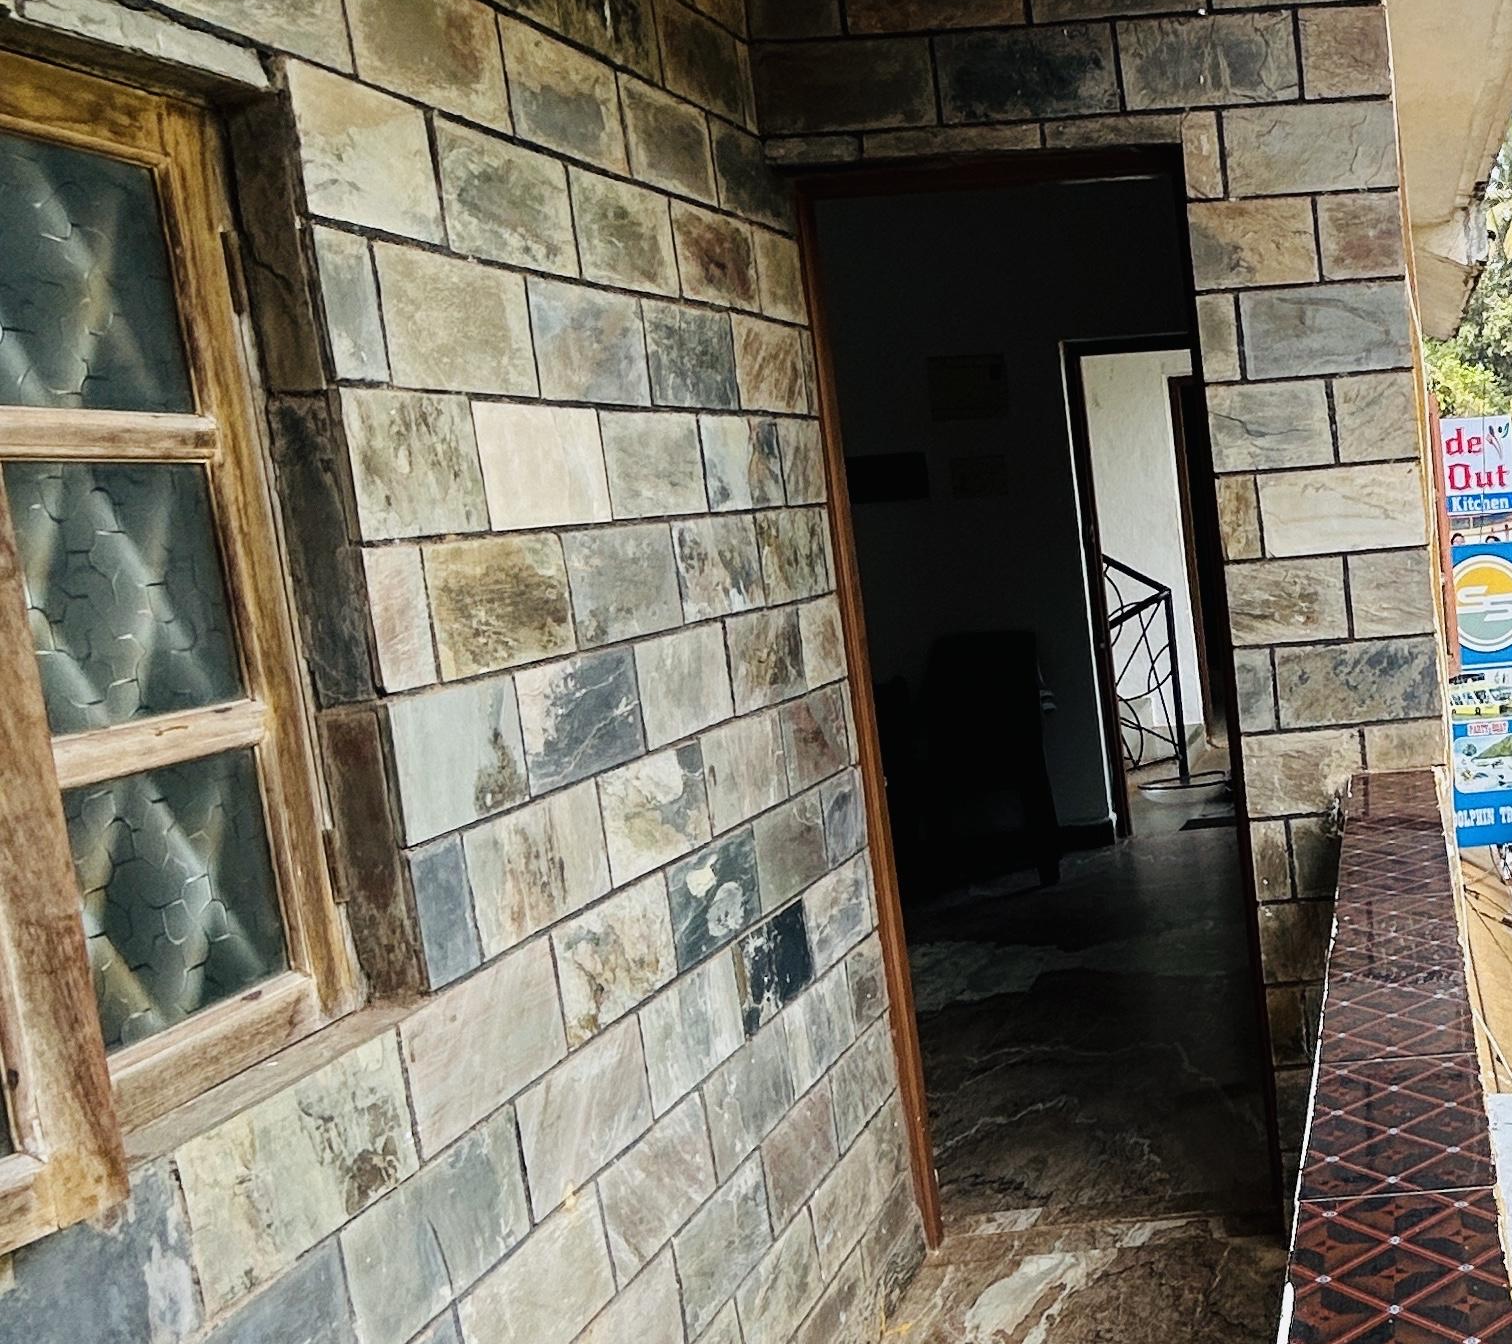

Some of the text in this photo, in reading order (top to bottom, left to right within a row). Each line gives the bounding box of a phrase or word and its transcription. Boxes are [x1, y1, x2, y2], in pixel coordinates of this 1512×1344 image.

[1445, 428, 1482, 455] de
[1448, 463, 1508, 490] Out
[1451, 497, 1509, 512] Kitchen
